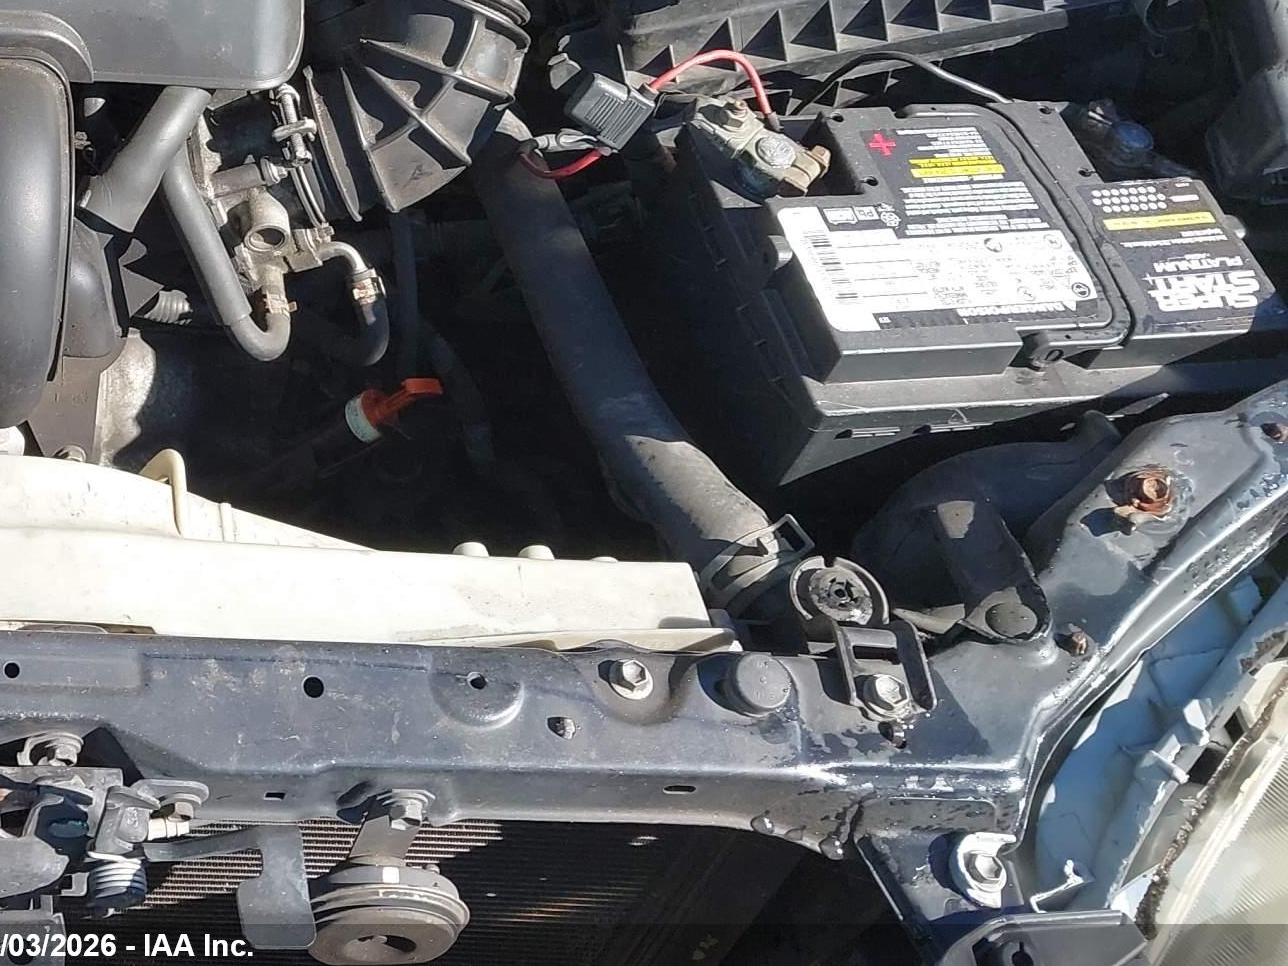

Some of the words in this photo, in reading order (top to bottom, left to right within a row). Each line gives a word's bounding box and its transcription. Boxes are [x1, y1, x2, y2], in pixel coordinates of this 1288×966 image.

[857, 209, 875, 218] Pb
[1153, 255, 1243, 274] PLATINUM
[1150, 270, 1260, 295] START
[1156, 291, 1259, 312] SUPER
